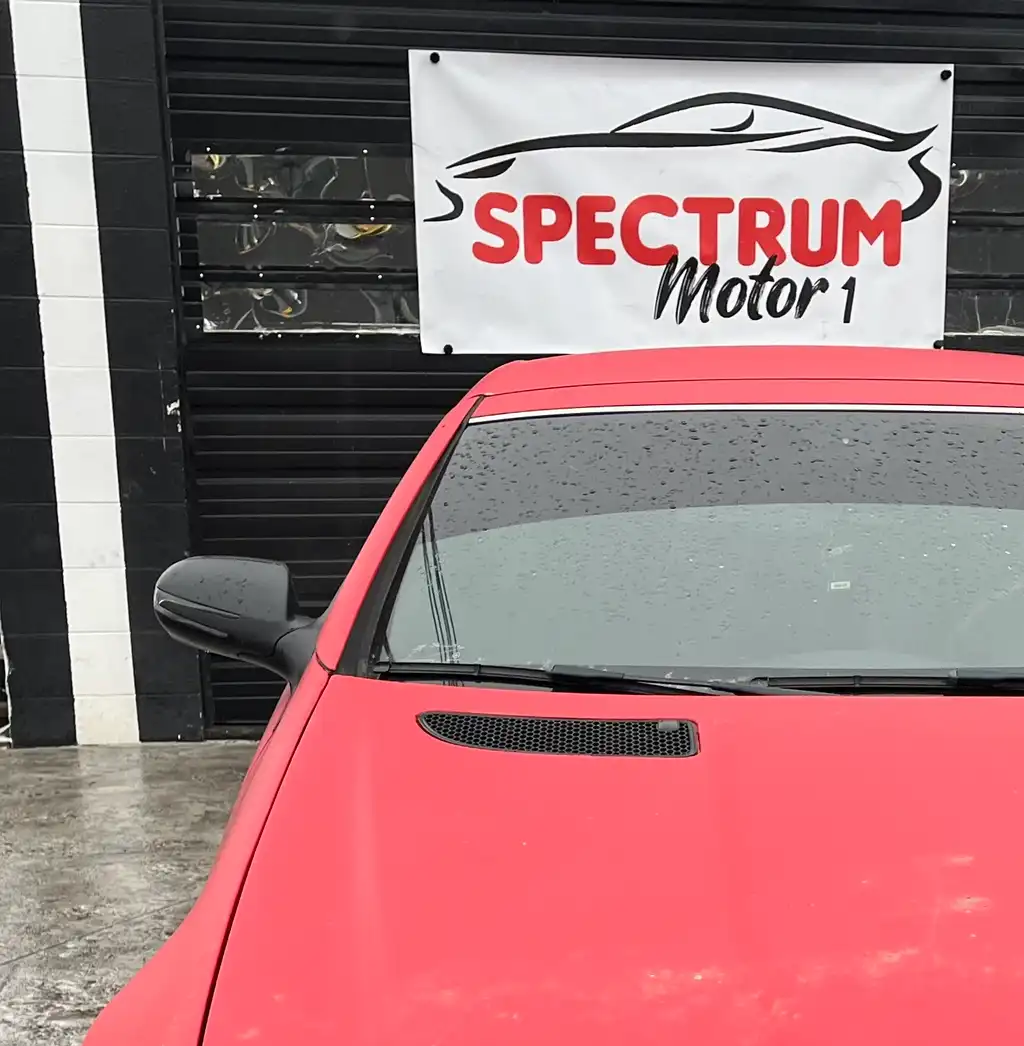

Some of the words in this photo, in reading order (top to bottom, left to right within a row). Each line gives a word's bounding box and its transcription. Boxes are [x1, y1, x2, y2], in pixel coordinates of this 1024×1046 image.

[472, 192, 902, 266] SPECTRUM
[654, 254, 829, 325] Motor
[842, 276, 857, 324] 1
